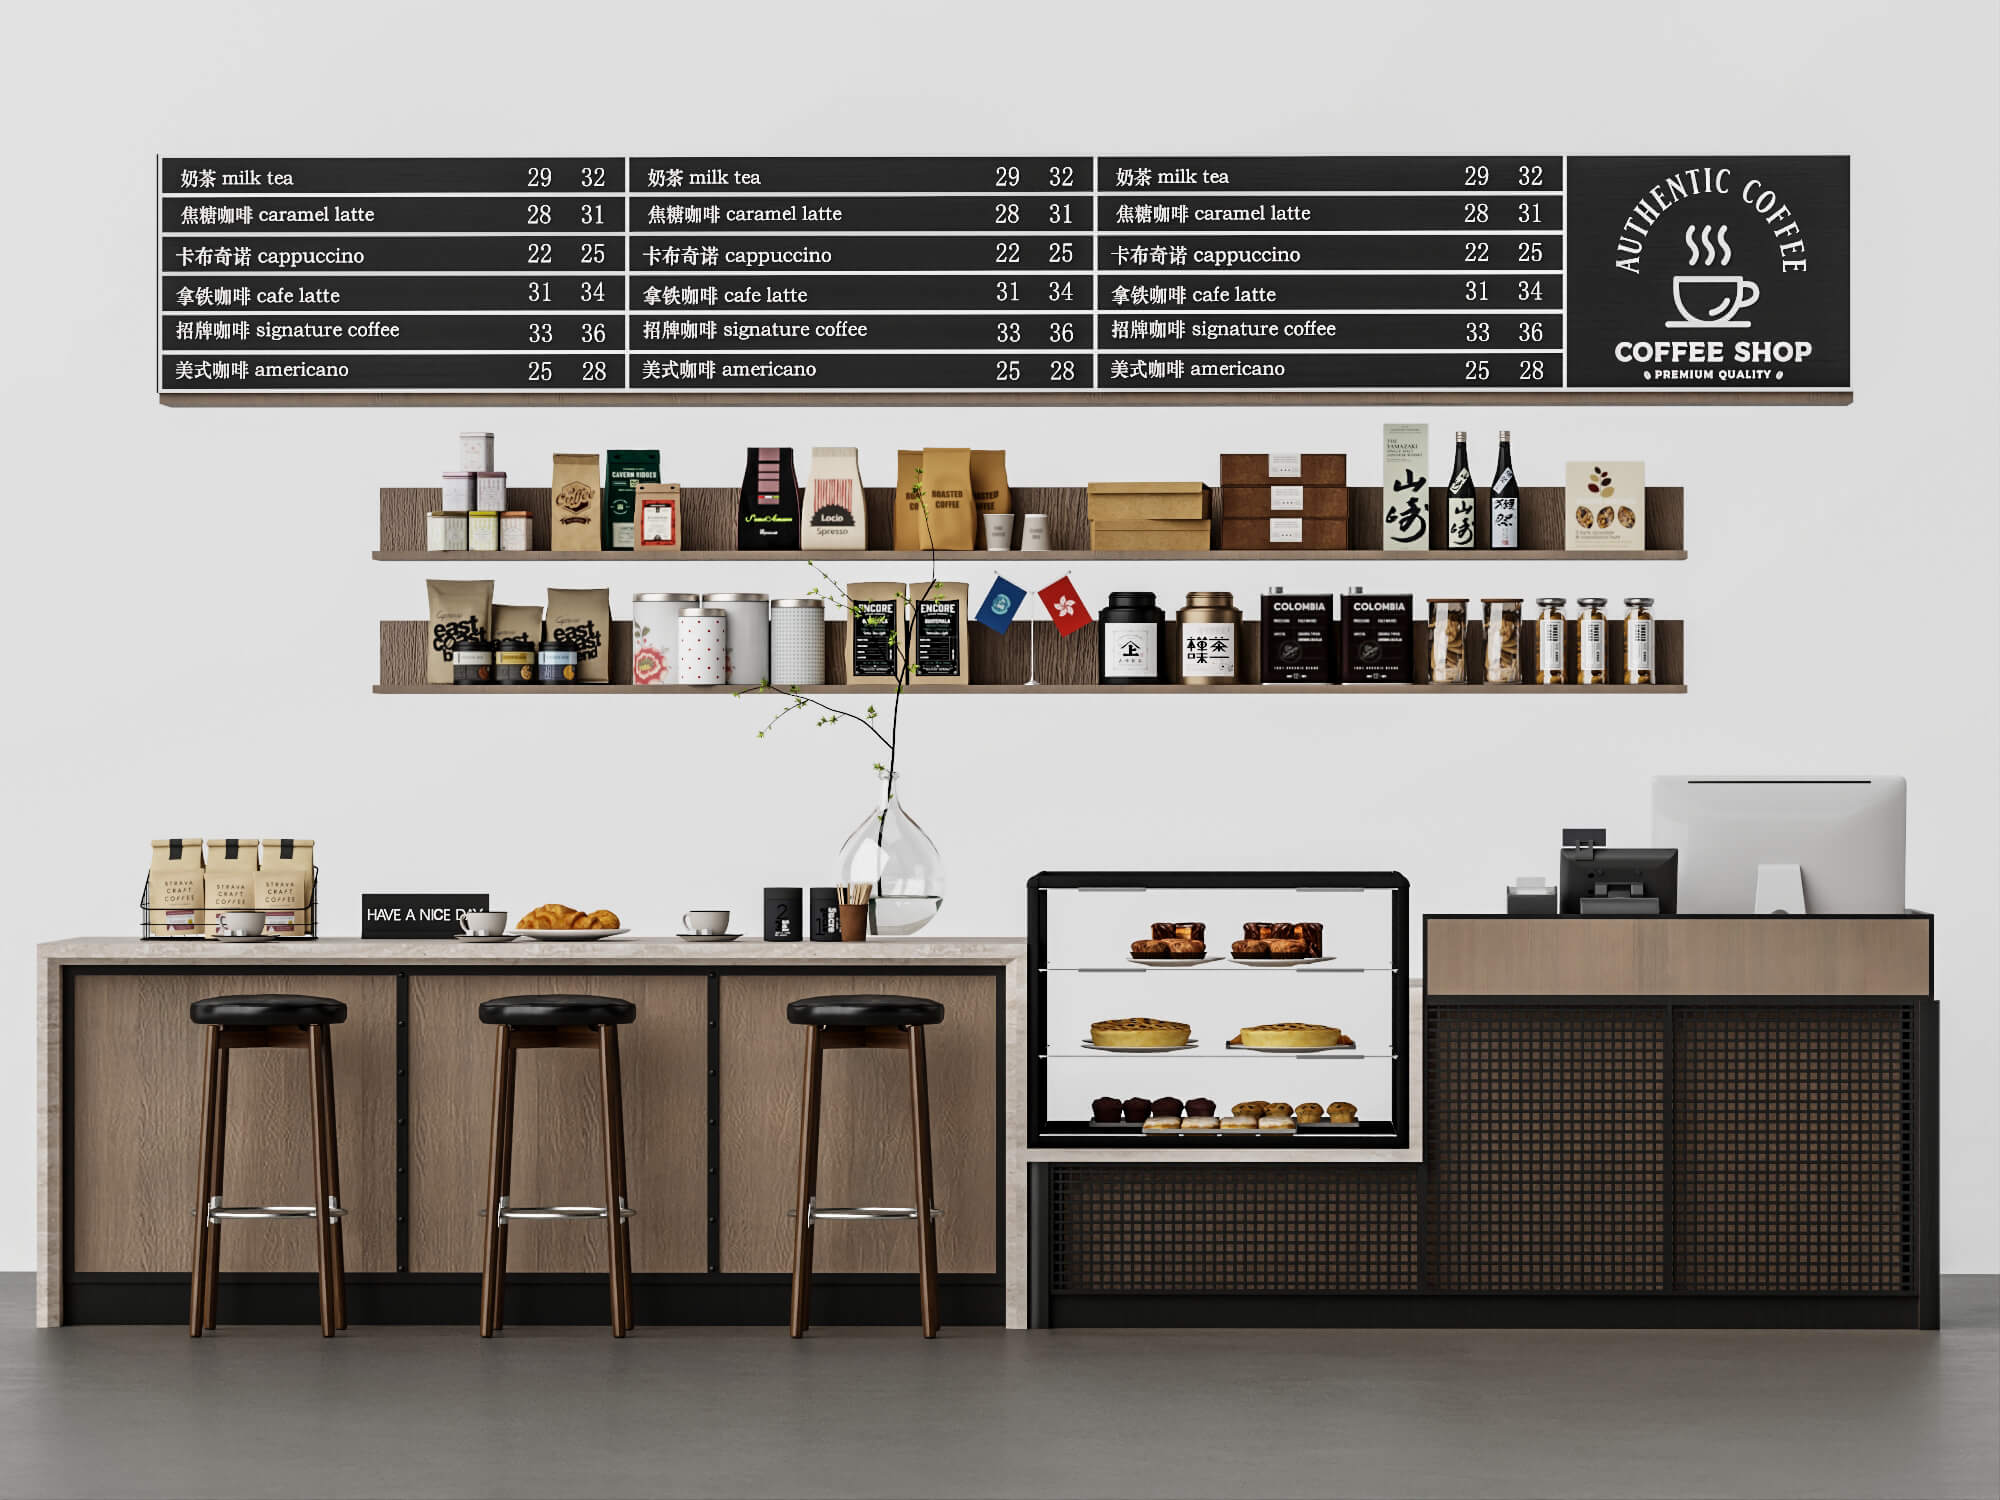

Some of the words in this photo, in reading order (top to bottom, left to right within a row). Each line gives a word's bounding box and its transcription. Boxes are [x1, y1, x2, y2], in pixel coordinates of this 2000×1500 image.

[180, 168, 217, 189] 奶茶
[221, 169, 262, 186] milk
[266, 171, 295, 186] tea
[527, 167, 552, 188] 29
[581, 167, 606, 188] 32
[647, 168, 684, 188] 奶茶
[688, 168, 730, 185] milk
[733, 170, 762, 185] tea
[995, 166, 1020, 187] 29
[1049, 166, 1074, 187] 32
[1115, 167, 1153, 187] 奶茶
[1157, 168, 1198, 184] milk
[1202, 169, 1230, 184] tea
[1464, 165, 1489, 186] 29
[1518, 165, 1543, 186] 32
[180, 205, 254, 225] 焦糖咖啡
[258, 205, 330, 222] caramel
[334, 205, 375, 222] latte
[527, 204, 552, 225] 28
[581, 204, 604, 225] 31
[647, 204, 721, 225] 焦糖咖啡
[726, 205, 797, 222] caramel
[801, 205, 843, 221] latte
[995, 203, 1020, 224] 28
[1049, 203, 1073, 224] 31
[1115, 203, 1190, 224] 焦糖咖啡
[1194, 204, 1266, 221] caramel
[1270, 204, 1311, 221] latte
[1464, 203, 1489, 223] 28
[1518, 202, 1542, 223] 31
[1615, 167, 1731, 274] AUTHENTIC
[1742, 179, 1808, 273] COFFEE
[175, 246, 252, 267] 卡布奇诺
[257, 247, 365, 268] cappuccino
[527, 243, 552, 264] 22
[580, 243, 605, 264] 25
[642, 245, 720, 267] 卡布奇诺
[724, 246, 832, 267] cappuccino
[995, 242, 1020, 263] 22
[1048, 242, 1073, 263] 25
[1110, 244, 1188, 266] 卡布奇诺
[1193, 246, 1301, 267] cappuccino
[1464, 242, 1489, 262] 22
[1518, 242, 1543, 262] 25
[175, 285, 252, 307] 拿铁咖啡
[256, 287, 294, 304] cafe
[298, 286, 341, 304] latte
[528, 281, 552, 302] 31
[580, 281, 605, 302] 34
[642, 285, 719, 306] 拿铁咖啡
[724, 286, 762, 303] cafe
[766, 286, 808, 303] latte
[996, 281, 1020, 302] 31
[1048, 281, 1074, 302] 34
[1111, 284, 1187, 306] 拿铁咖啡
[1192, 285, 1230, 303] cafe
[1234, 285, 1277, 302] latte
[1465, 280, 1489, 301] 31
[1518, 280, 1543, 301] 34
[175, 320, 251, 341] 招牌咖啡
[256, 321, 343, 341] signature
[347, 320, 400, 338] coffee
[529, 323, 553, 343] 33
[581, 322, 606, 343] 36
[642, 319, 718, 340] 招牌咖啡
[723, 321, 811, 341] signature
[815, 320, 868, 337] coffee
[997, 322, 1021, 343] 33
[1049, 322, 1074, 343] 36
[1111, 319, 1186, 340] 招牌咖啡
[1191, 320, 1279, 340] signature
[1283, 319, 1337, 337] coffee
[1466, 322, 1490, 342] 33
[1518, 322, 1543, 342] 36
[1614, 341, 1724, 363] COFFEE
[1734, 341, 1813, 363] SHOP
[175, 359, 250, 380] 美式咖啡
[254, 361, 349, 377] americano
[528, 361, 553, 381] 25
[582, 361, 607, 381] 28
[642, 359, 717, 380] 美式咖啡
[721, 360, 817, 377] americano
[996, 360, 1021, 381] 25
[1050, 360, 1075, 381] 28
[1110, 359, 1185, 379] 美式咖啡
[1190, 360, 1286, 376] americano
[1465, 360, 1490, 381] 25
[1519, 360, 1544, 380] 28
[1654, 369, 1714, 380] PREMIUM
[1718, 369, 1772, 381] QUALITY
[935, 500, 960, 509] COFFEE
[920, 603, 956, 614] ENCORE
[1273, 602, 1326, 612] COLOMBIA
[1353, 602, 1406, 612] COLOMBIA
[434, 615, 479, 638] east
[164, 880, 194, 888] STRAVA
[166, 887, 192, 895] CRAFT
[267, 888, 294, 896] CRAFT
[164, 894, 195, 903] COFFEE
[264, 896, 297, 904] COFFEE
[367, 908, 402, 921] HAVE
[405, 908, 416, 921] A
[419, 908, 451, 921] NICE
